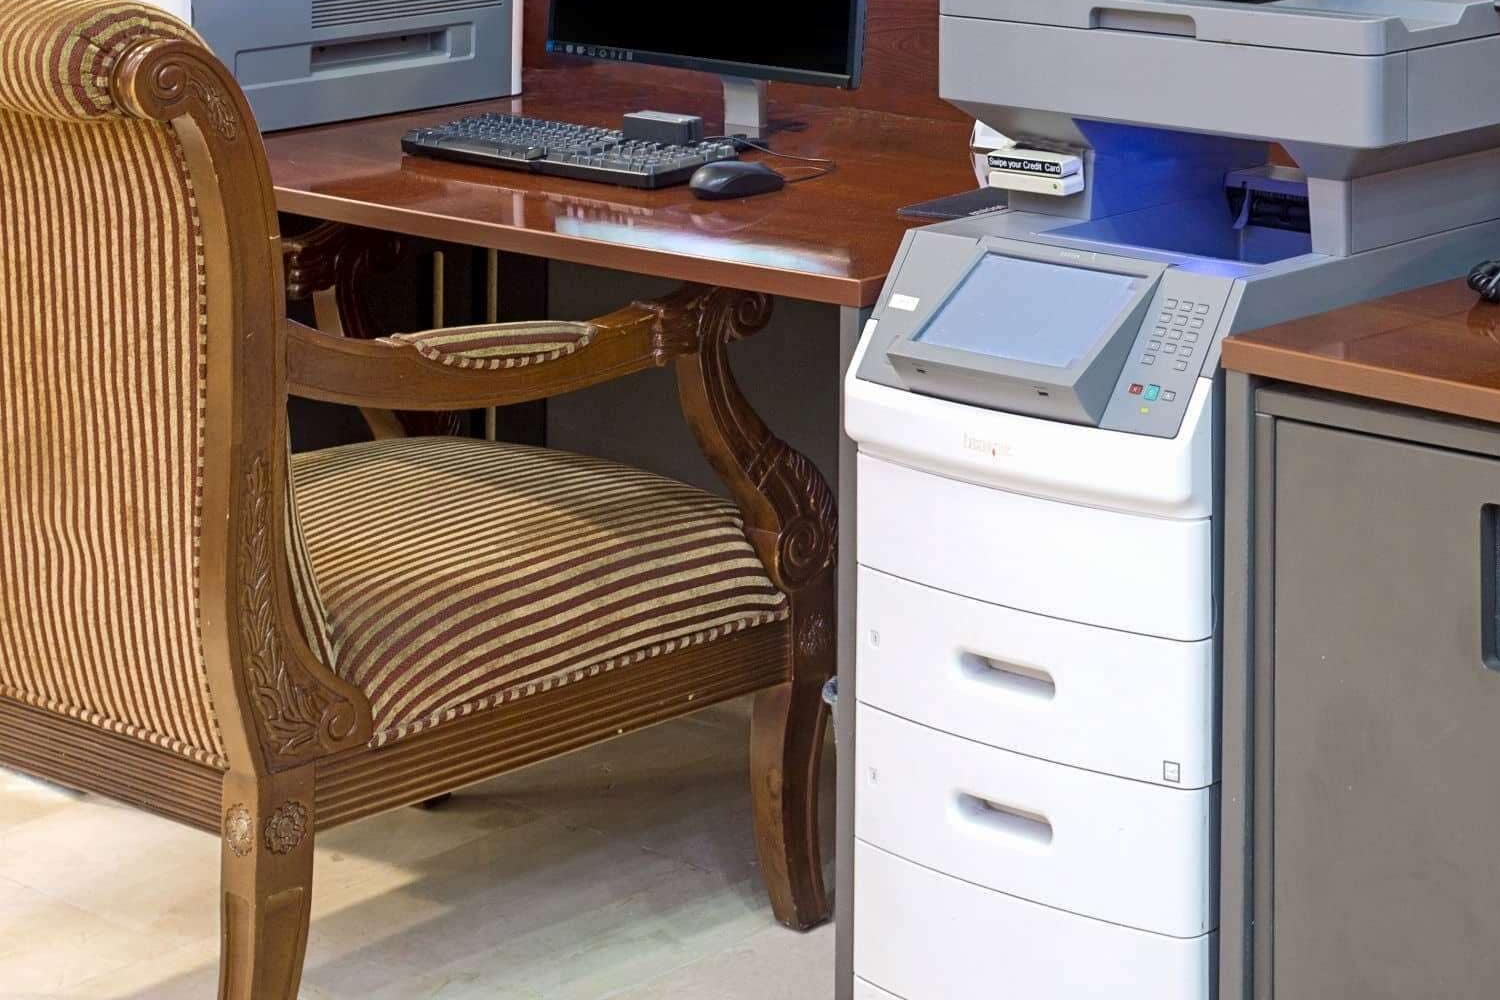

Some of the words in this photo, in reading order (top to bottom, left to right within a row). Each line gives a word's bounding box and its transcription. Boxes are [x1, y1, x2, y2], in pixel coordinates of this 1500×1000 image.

[989, 156, 1007, 168] Swipe
[1008, 160, 1022, 169] your
[1023, 160, 1043, 171] Credit
[1044, 163, 1061, 173] Card
